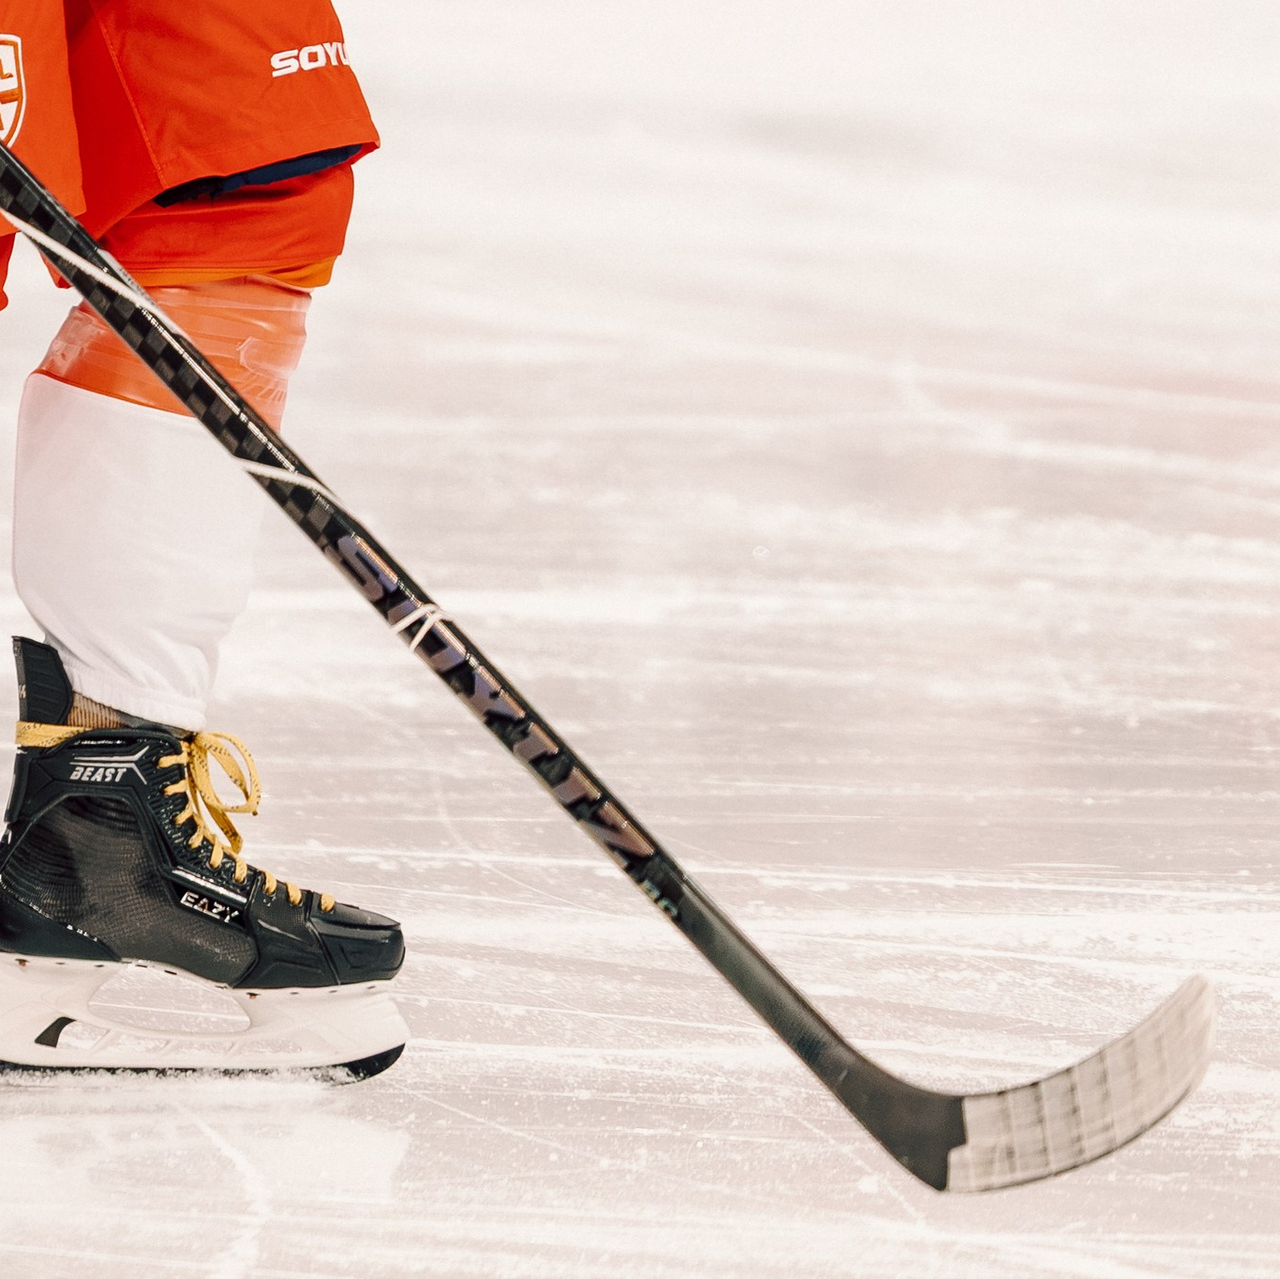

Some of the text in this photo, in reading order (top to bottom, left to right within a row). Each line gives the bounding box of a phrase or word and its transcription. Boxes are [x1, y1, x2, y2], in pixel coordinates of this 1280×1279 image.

[270, 41, 352, 78] SOYU
[69, 766, 128, 782] BEAST
[180, 891, 240, 923] EAZY
